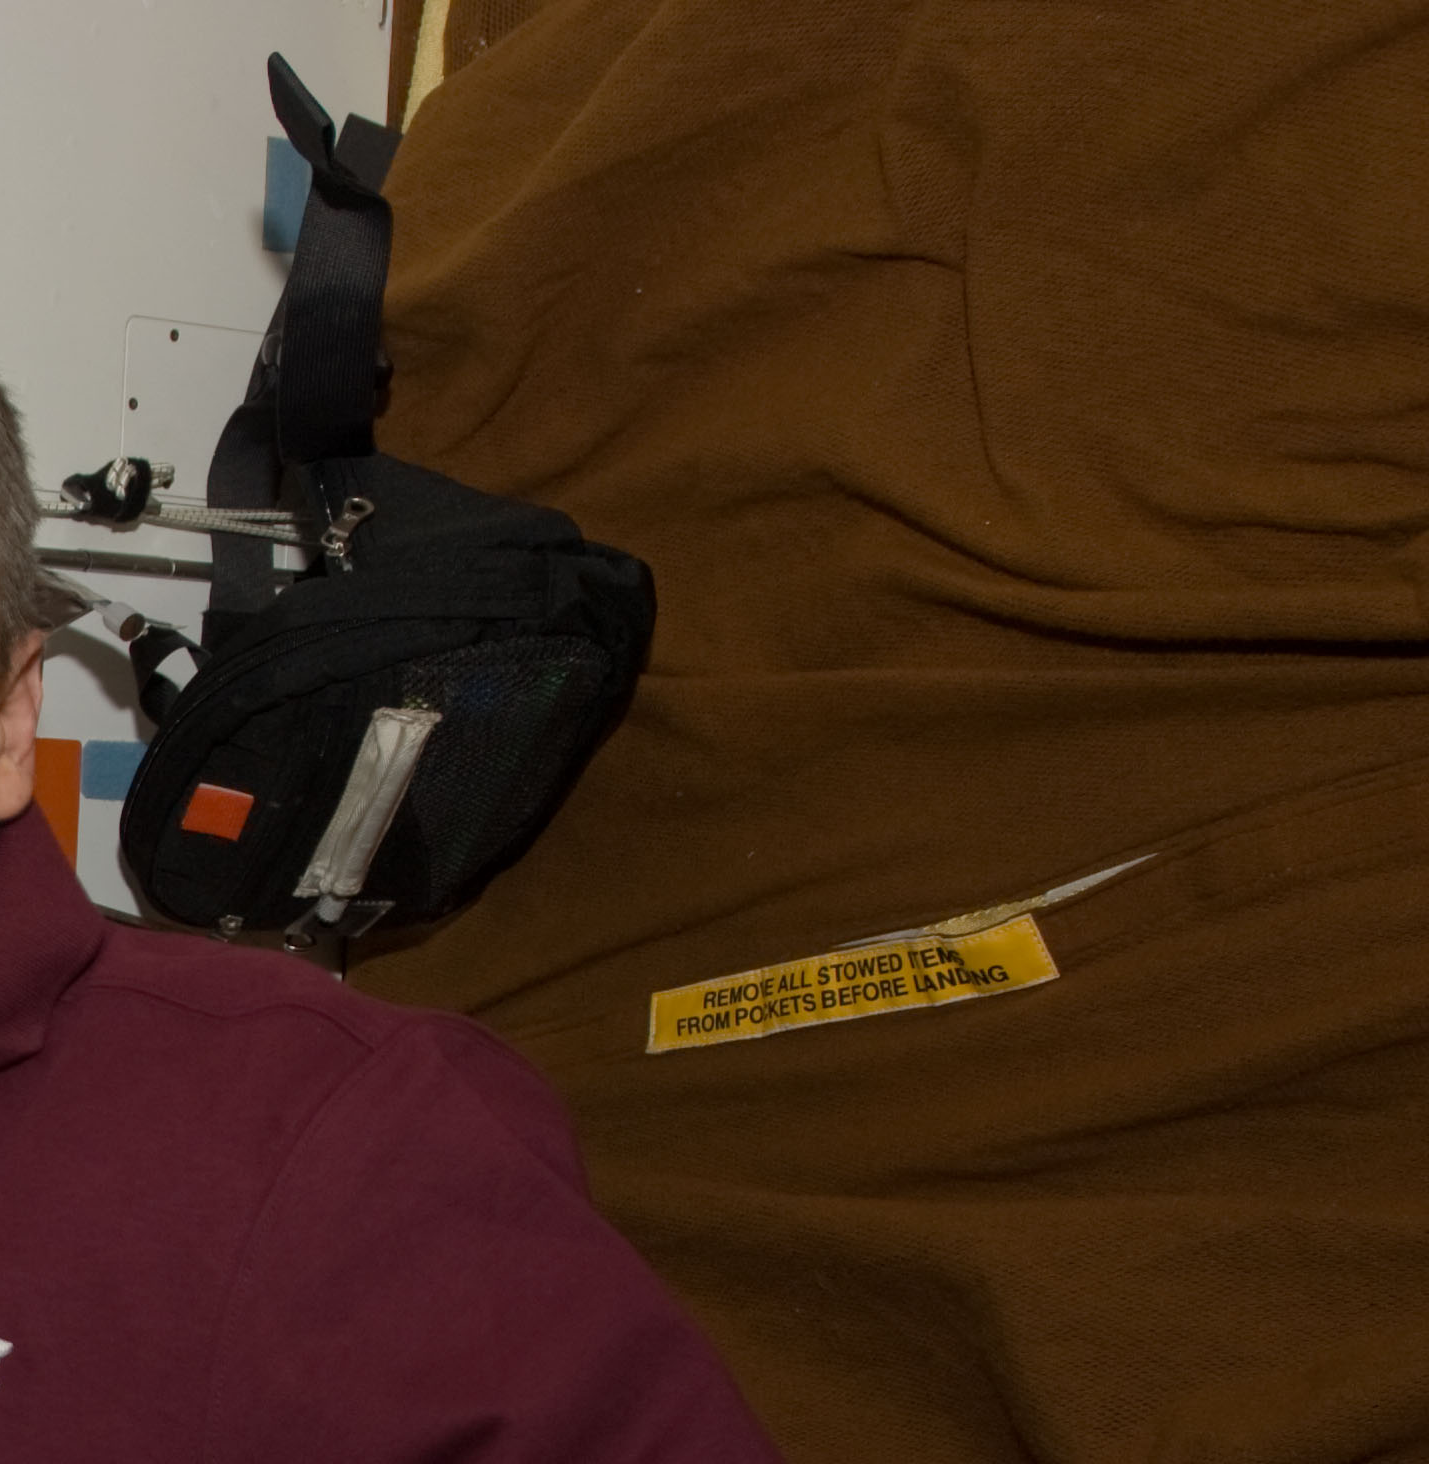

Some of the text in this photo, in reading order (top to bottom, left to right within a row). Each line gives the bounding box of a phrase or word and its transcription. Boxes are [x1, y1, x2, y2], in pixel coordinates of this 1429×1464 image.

[777, 969, 814, 993] ALL
[817, 953, 903, 984] STOWED
[909, 947, 966, 970] ITEMS
[676, 1007, 731, 1036] FROM
[821, 975, 912, 1010] BEFORE
[915, 964, 1009, 994] LANDING
